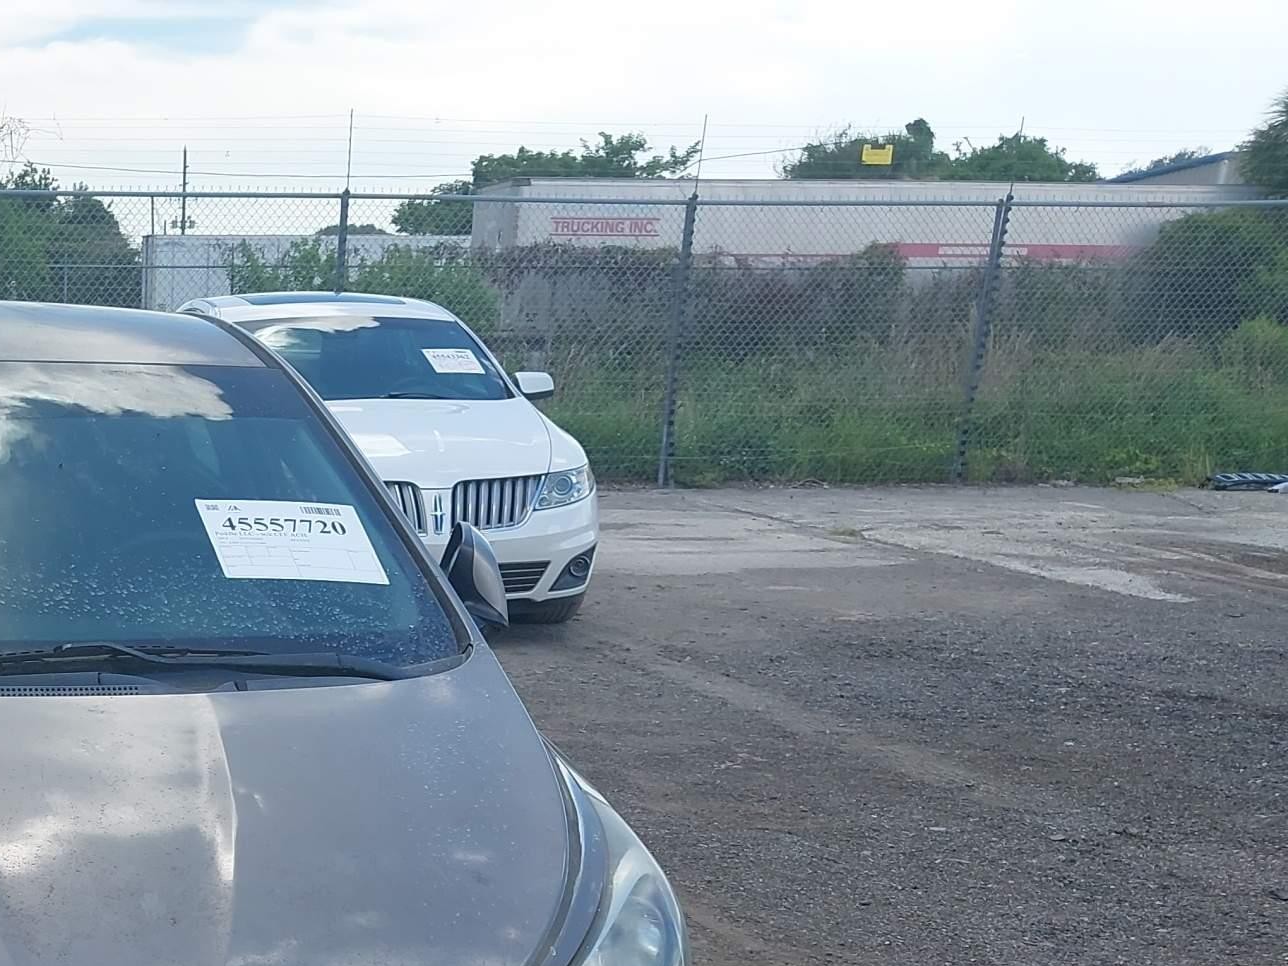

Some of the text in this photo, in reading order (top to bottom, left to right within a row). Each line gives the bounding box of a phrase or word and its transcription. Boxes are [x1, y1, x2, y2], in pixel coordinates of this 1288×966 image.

[552, 220, 658, 234] TRUCKING INC.
[222, 516, 347, 536] 45557720
